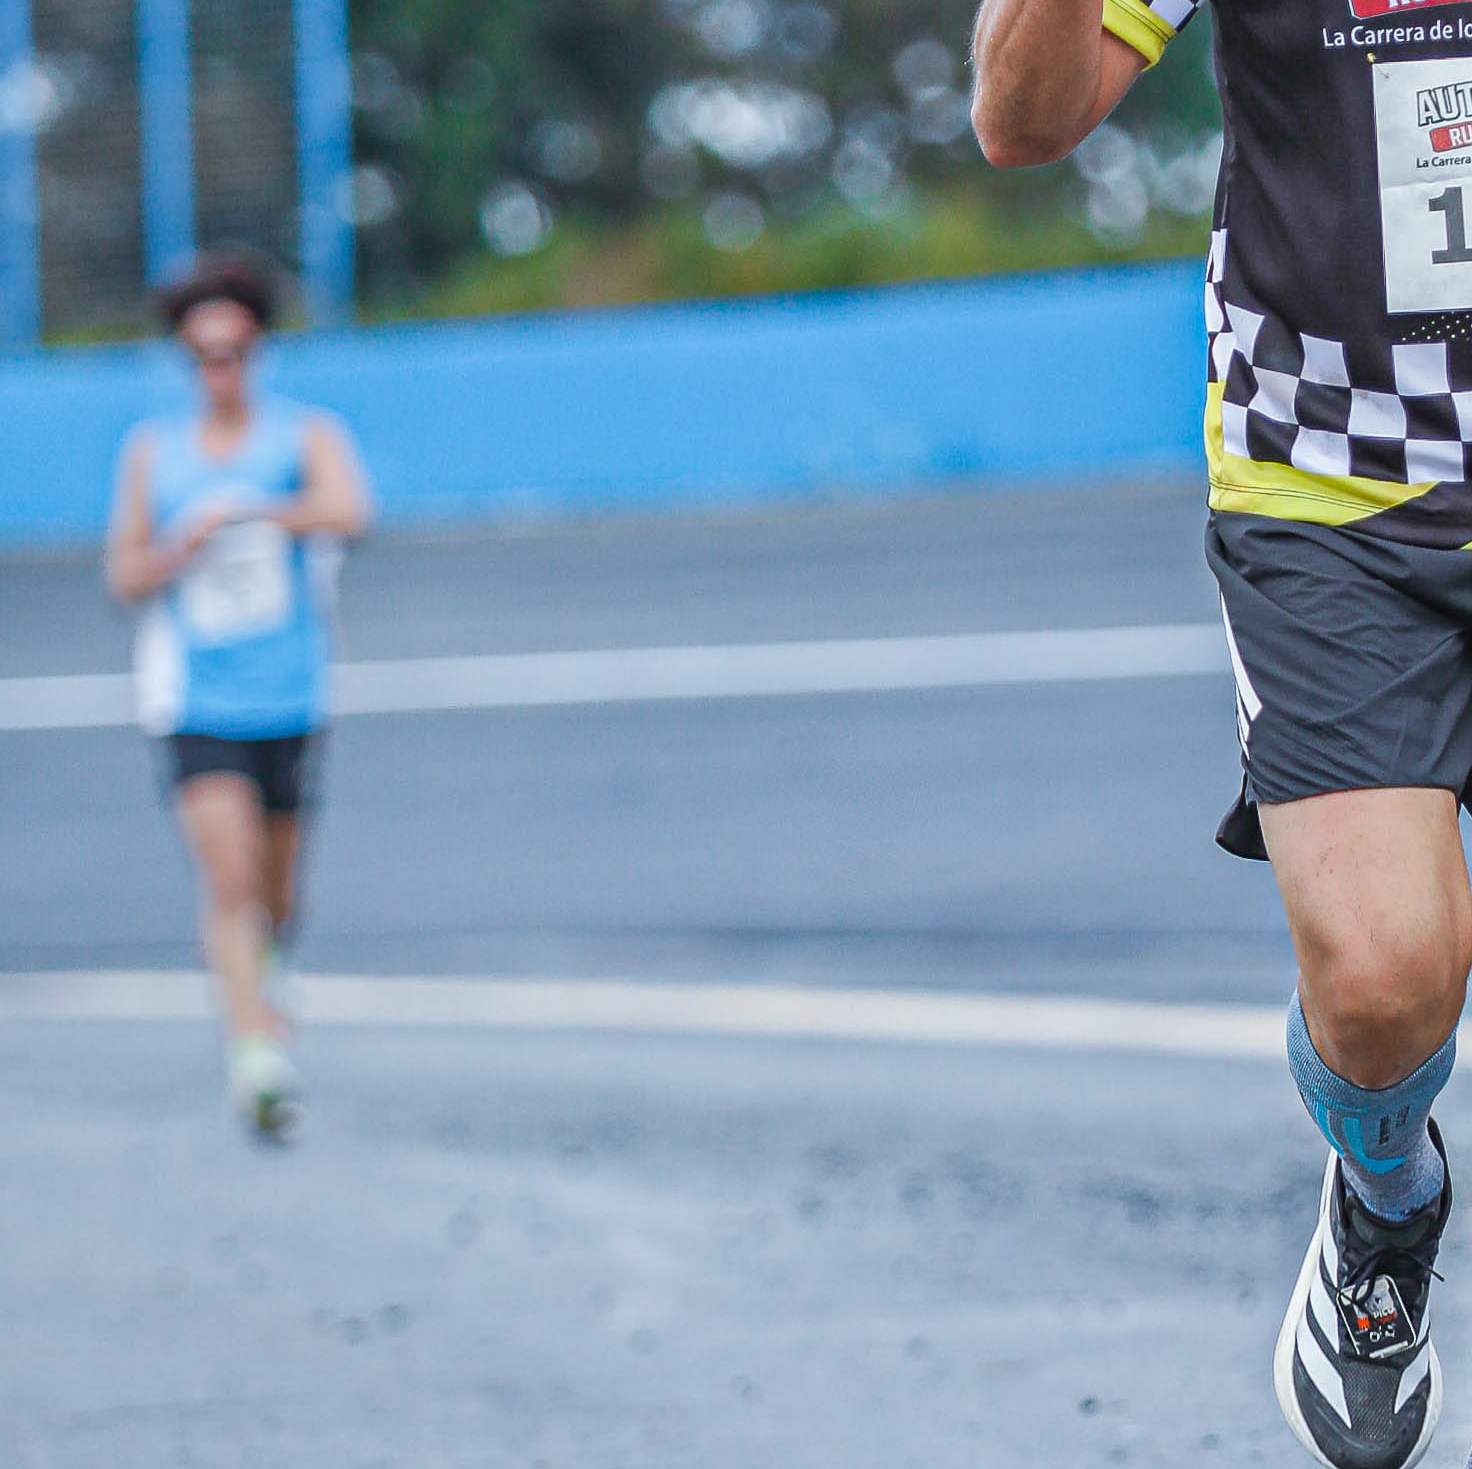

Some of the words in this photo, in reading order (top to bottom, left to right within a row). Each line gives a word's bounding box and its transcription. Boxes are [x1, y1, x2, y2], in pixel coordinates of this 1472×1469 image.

[1322, 27, 1345, 48] La
[1350, 24, 1424, 46] Carrera
[1428, 19, 1453, 41] de
[1416, 158, 1429, 168] La
[1431, 156, 1471, 168] Carrera
